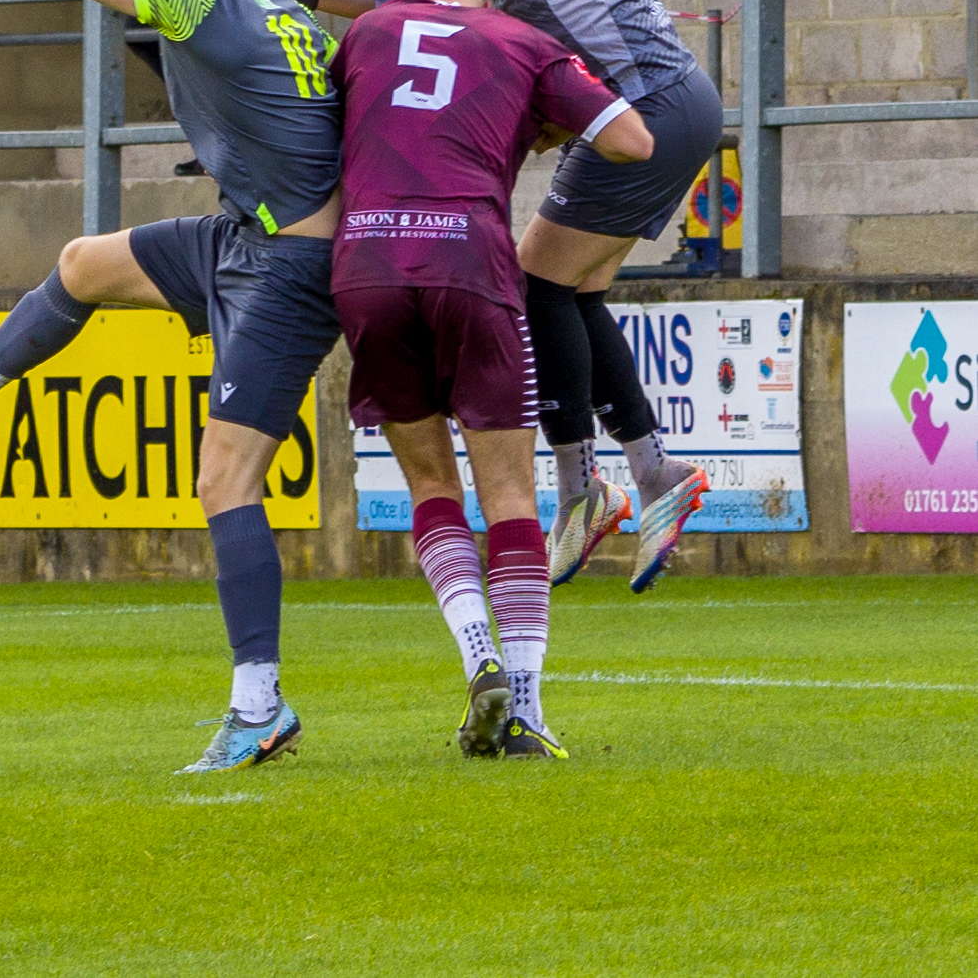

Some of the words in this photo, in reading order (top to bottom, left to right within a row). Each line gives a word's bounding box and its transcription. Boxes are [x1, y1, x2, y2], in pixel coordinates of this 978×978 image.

[391, 19, 466, 111] 5
[346, 212, 395, 227] SIMON
[414, 213, 468, 228] JAMES
[618, 313, 694, 386] INS
[955, 353, 978, 412] S
[904, 489, 949, 513] 01761
[951, 489, 978, 513] 235
